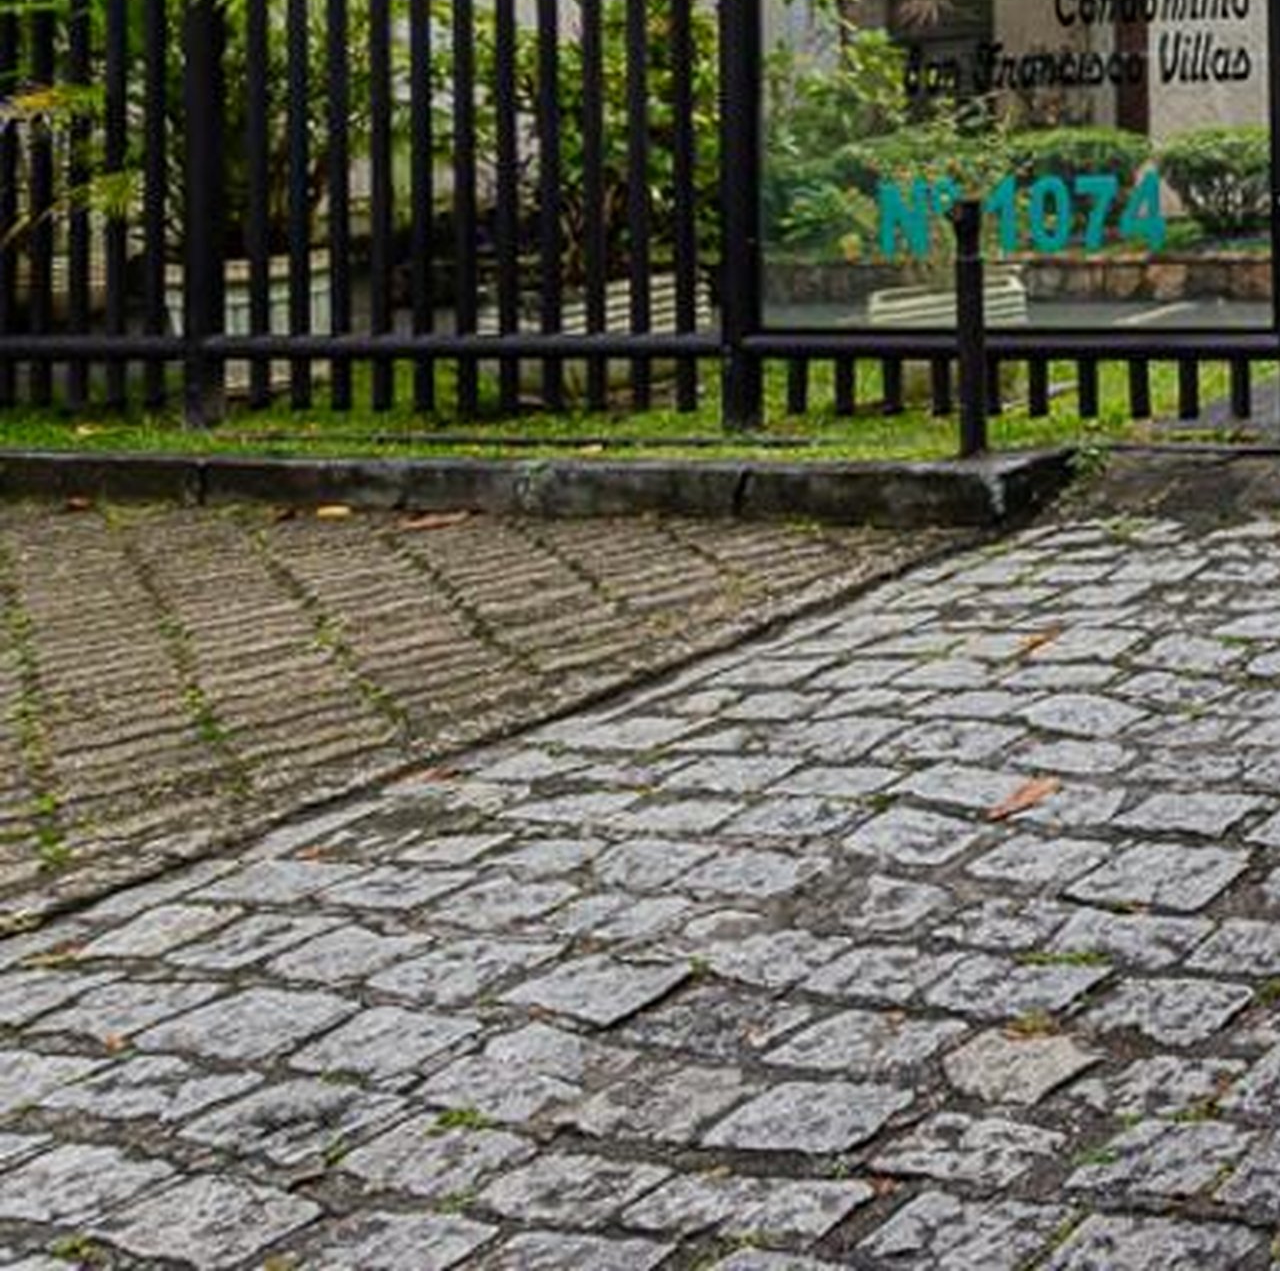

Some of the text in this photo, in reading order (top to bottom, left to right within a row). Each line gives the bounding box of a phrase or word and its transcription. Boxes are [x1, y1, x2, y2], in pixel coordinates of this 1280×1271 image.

[976, 41, 1145, 91] Francisco
[1158, 29, 1252, 85] Villas
[984, 167, 1166, 257] 1074
